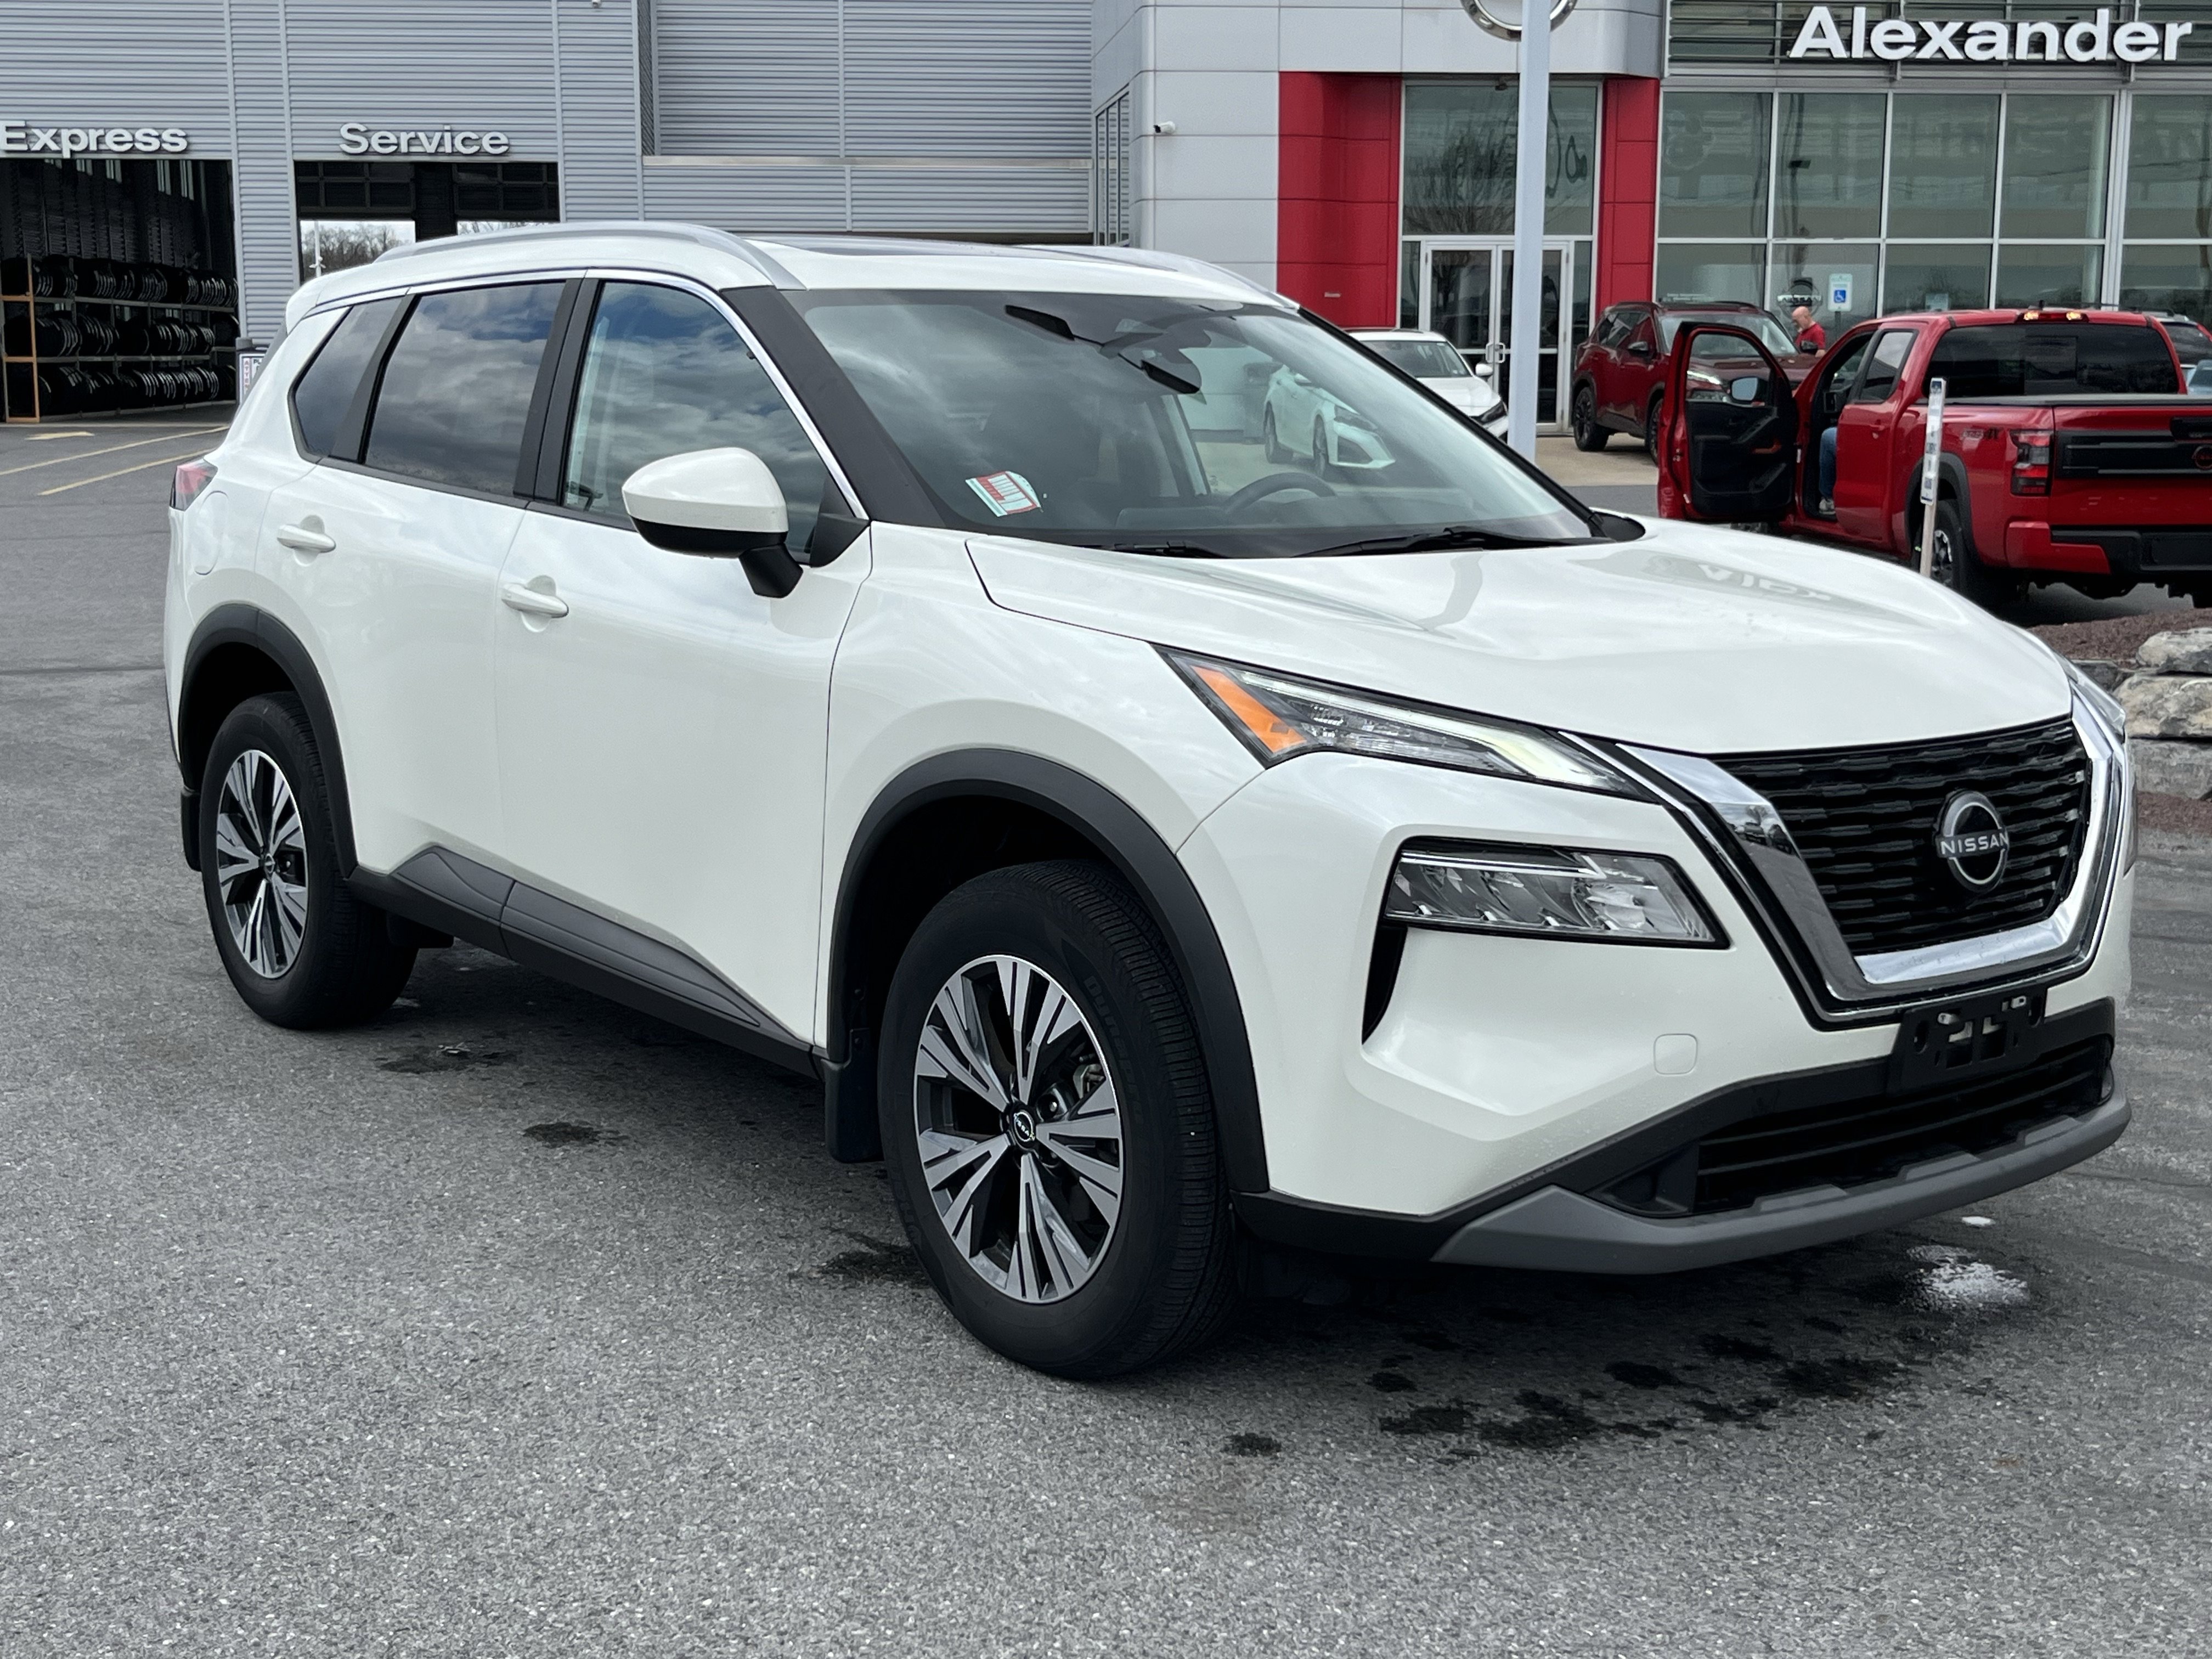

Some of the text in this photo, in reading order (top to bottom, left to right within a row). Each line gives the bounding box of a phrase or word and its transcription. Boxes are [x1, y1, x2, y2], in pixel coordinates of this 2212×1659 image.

[1788, 5, 2192, 61] Alexander
[0, 121, 188, 159] Express
[339, 122, 510, 156] Service
[1940, 832, 2008, 855] NISSAN
